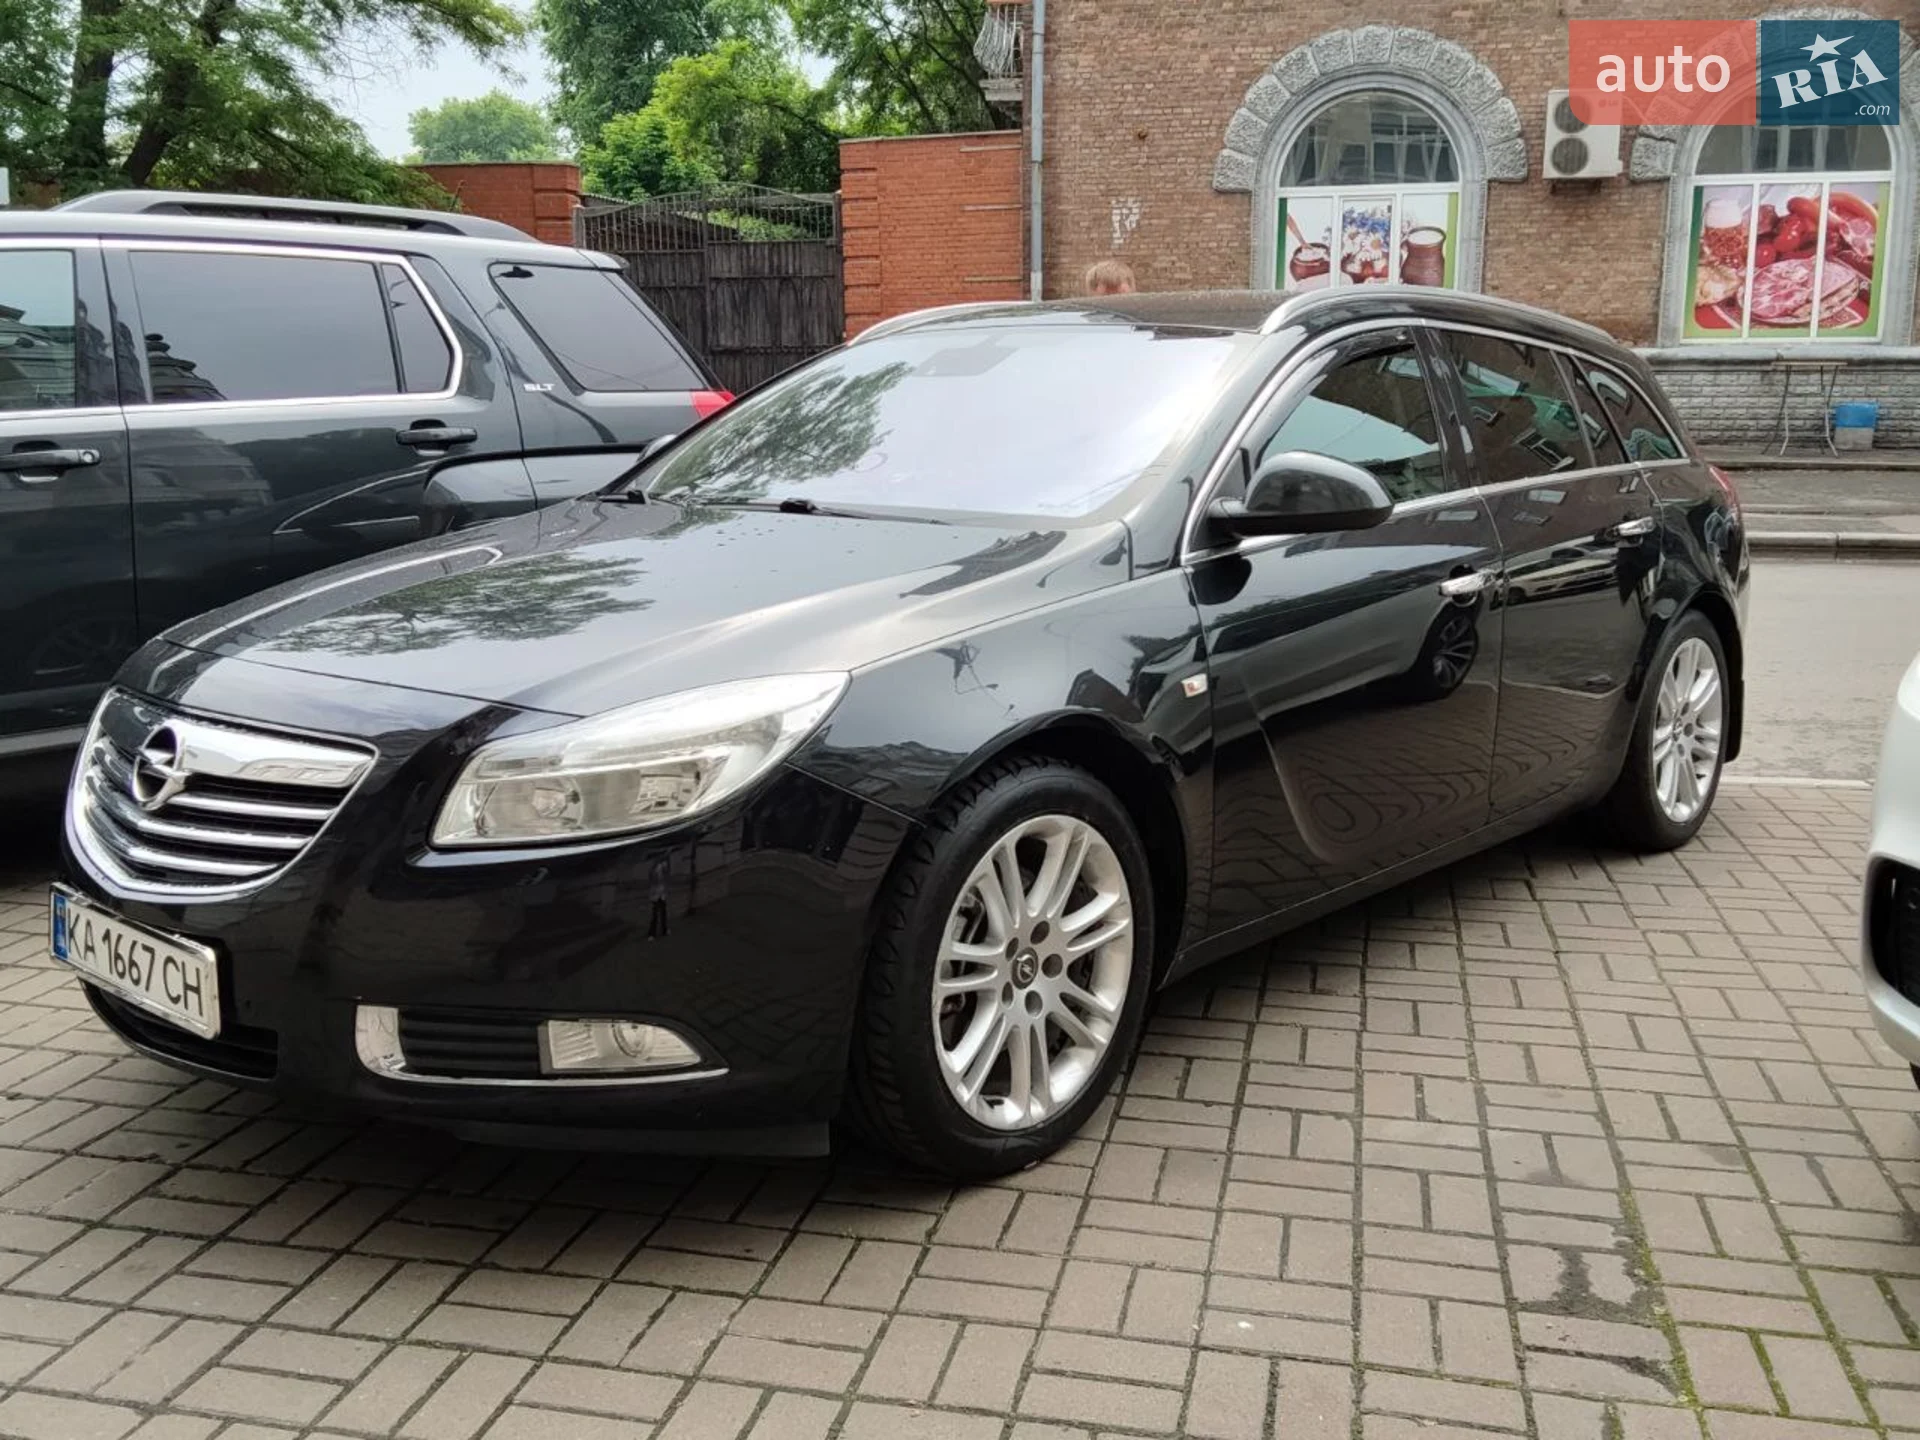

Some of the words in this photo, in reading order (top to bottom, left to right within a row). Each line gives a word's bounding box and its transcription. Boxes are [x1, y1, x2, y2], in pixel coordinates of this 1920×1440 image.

[67, 907, 97, 964] KA
[101, 928, 156, 992] 1667
[163, 955, 204, 1017] CH
